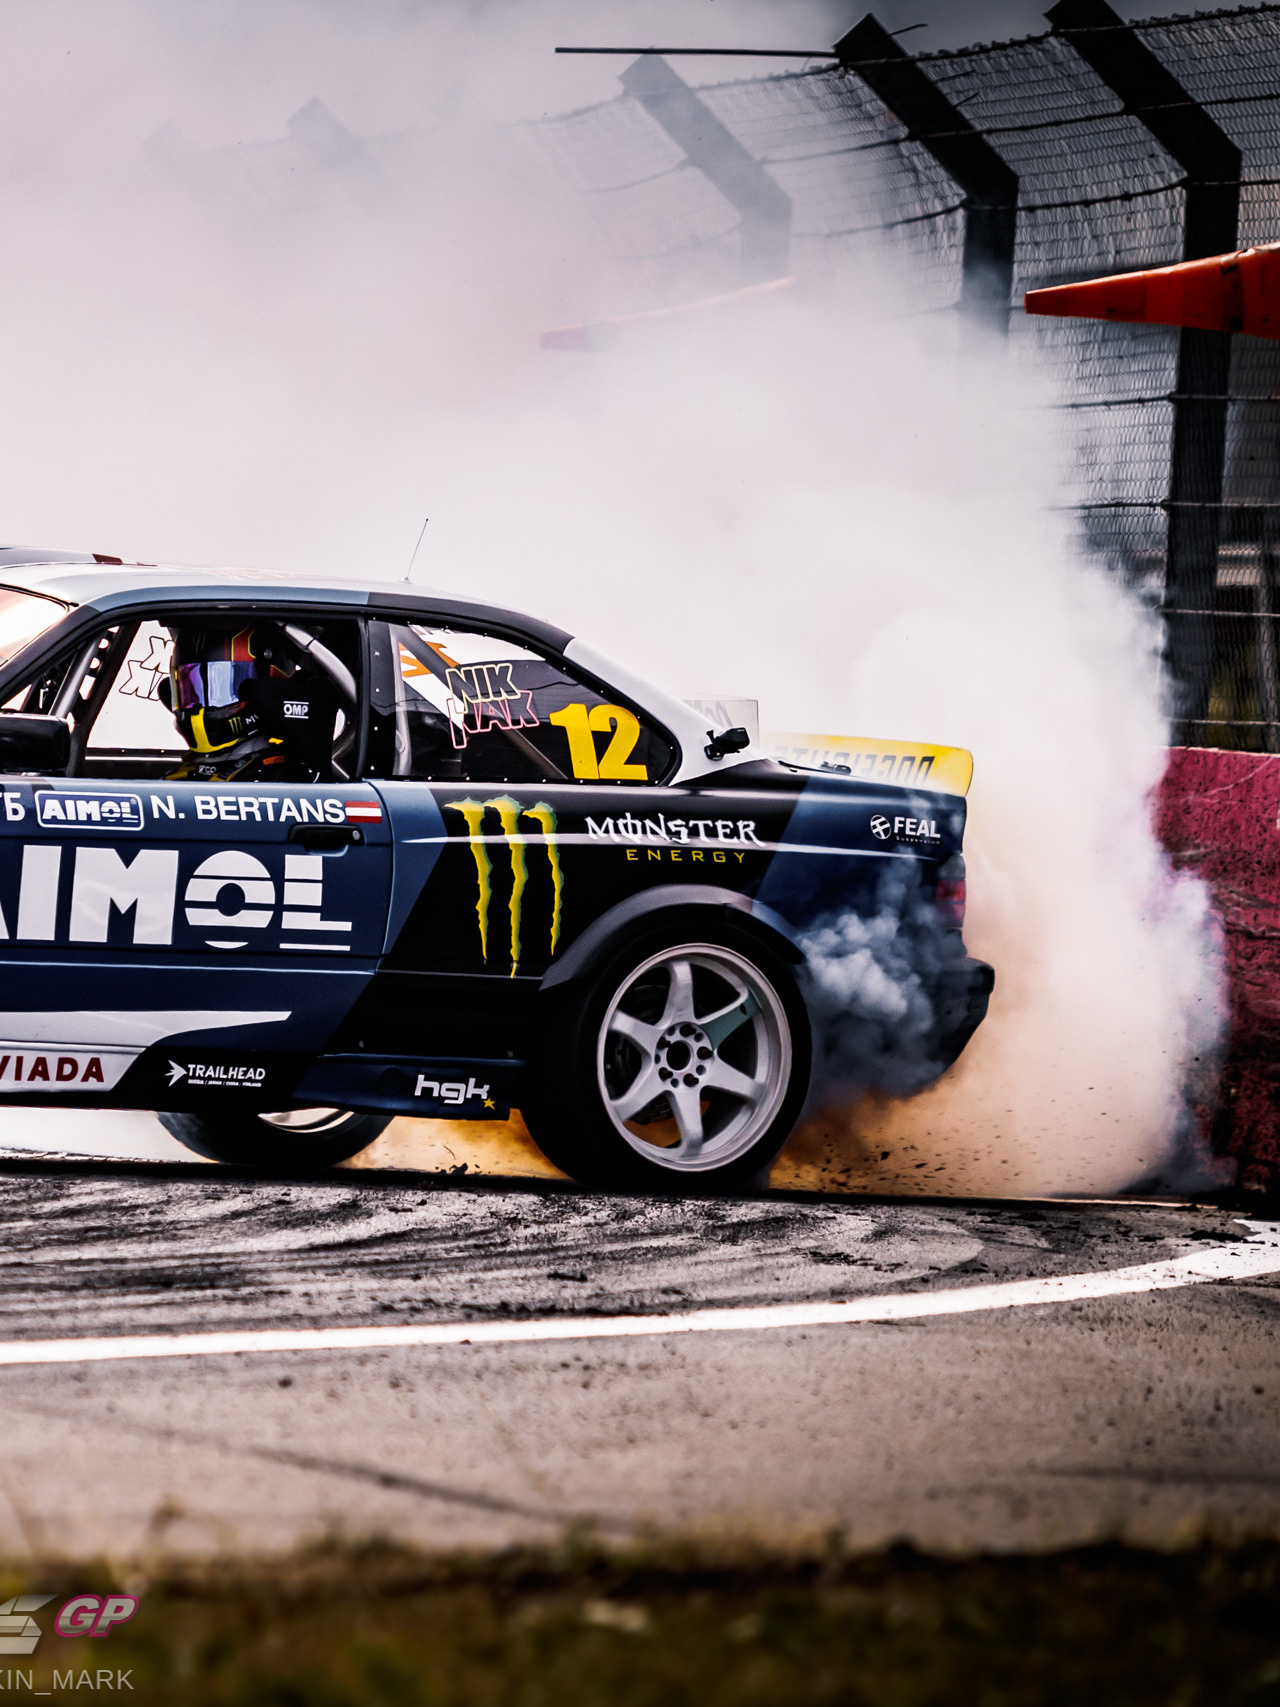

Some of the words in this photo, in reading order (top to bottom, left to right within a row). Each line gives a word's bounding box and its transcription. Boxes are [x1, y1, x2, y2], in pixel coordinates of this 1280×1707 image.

[445, 663, 521, 714] NIK
[283, 704, 309, 716] OMP
[446, 690, 539, 749] NAK
[549, 703, 648, 780] 12
[42, 799, 138, 823] AIMOL
[152, 795, 185, 820] N.
[195, 796, 346, 824] BERTANS
[894, 816, 941, 838] FEAL
[626, 849, 745, 863] ENERGY
[188, 1064, 266, 1080] TRAILHEAD
[414, 1074, 490, 1104] hgk
